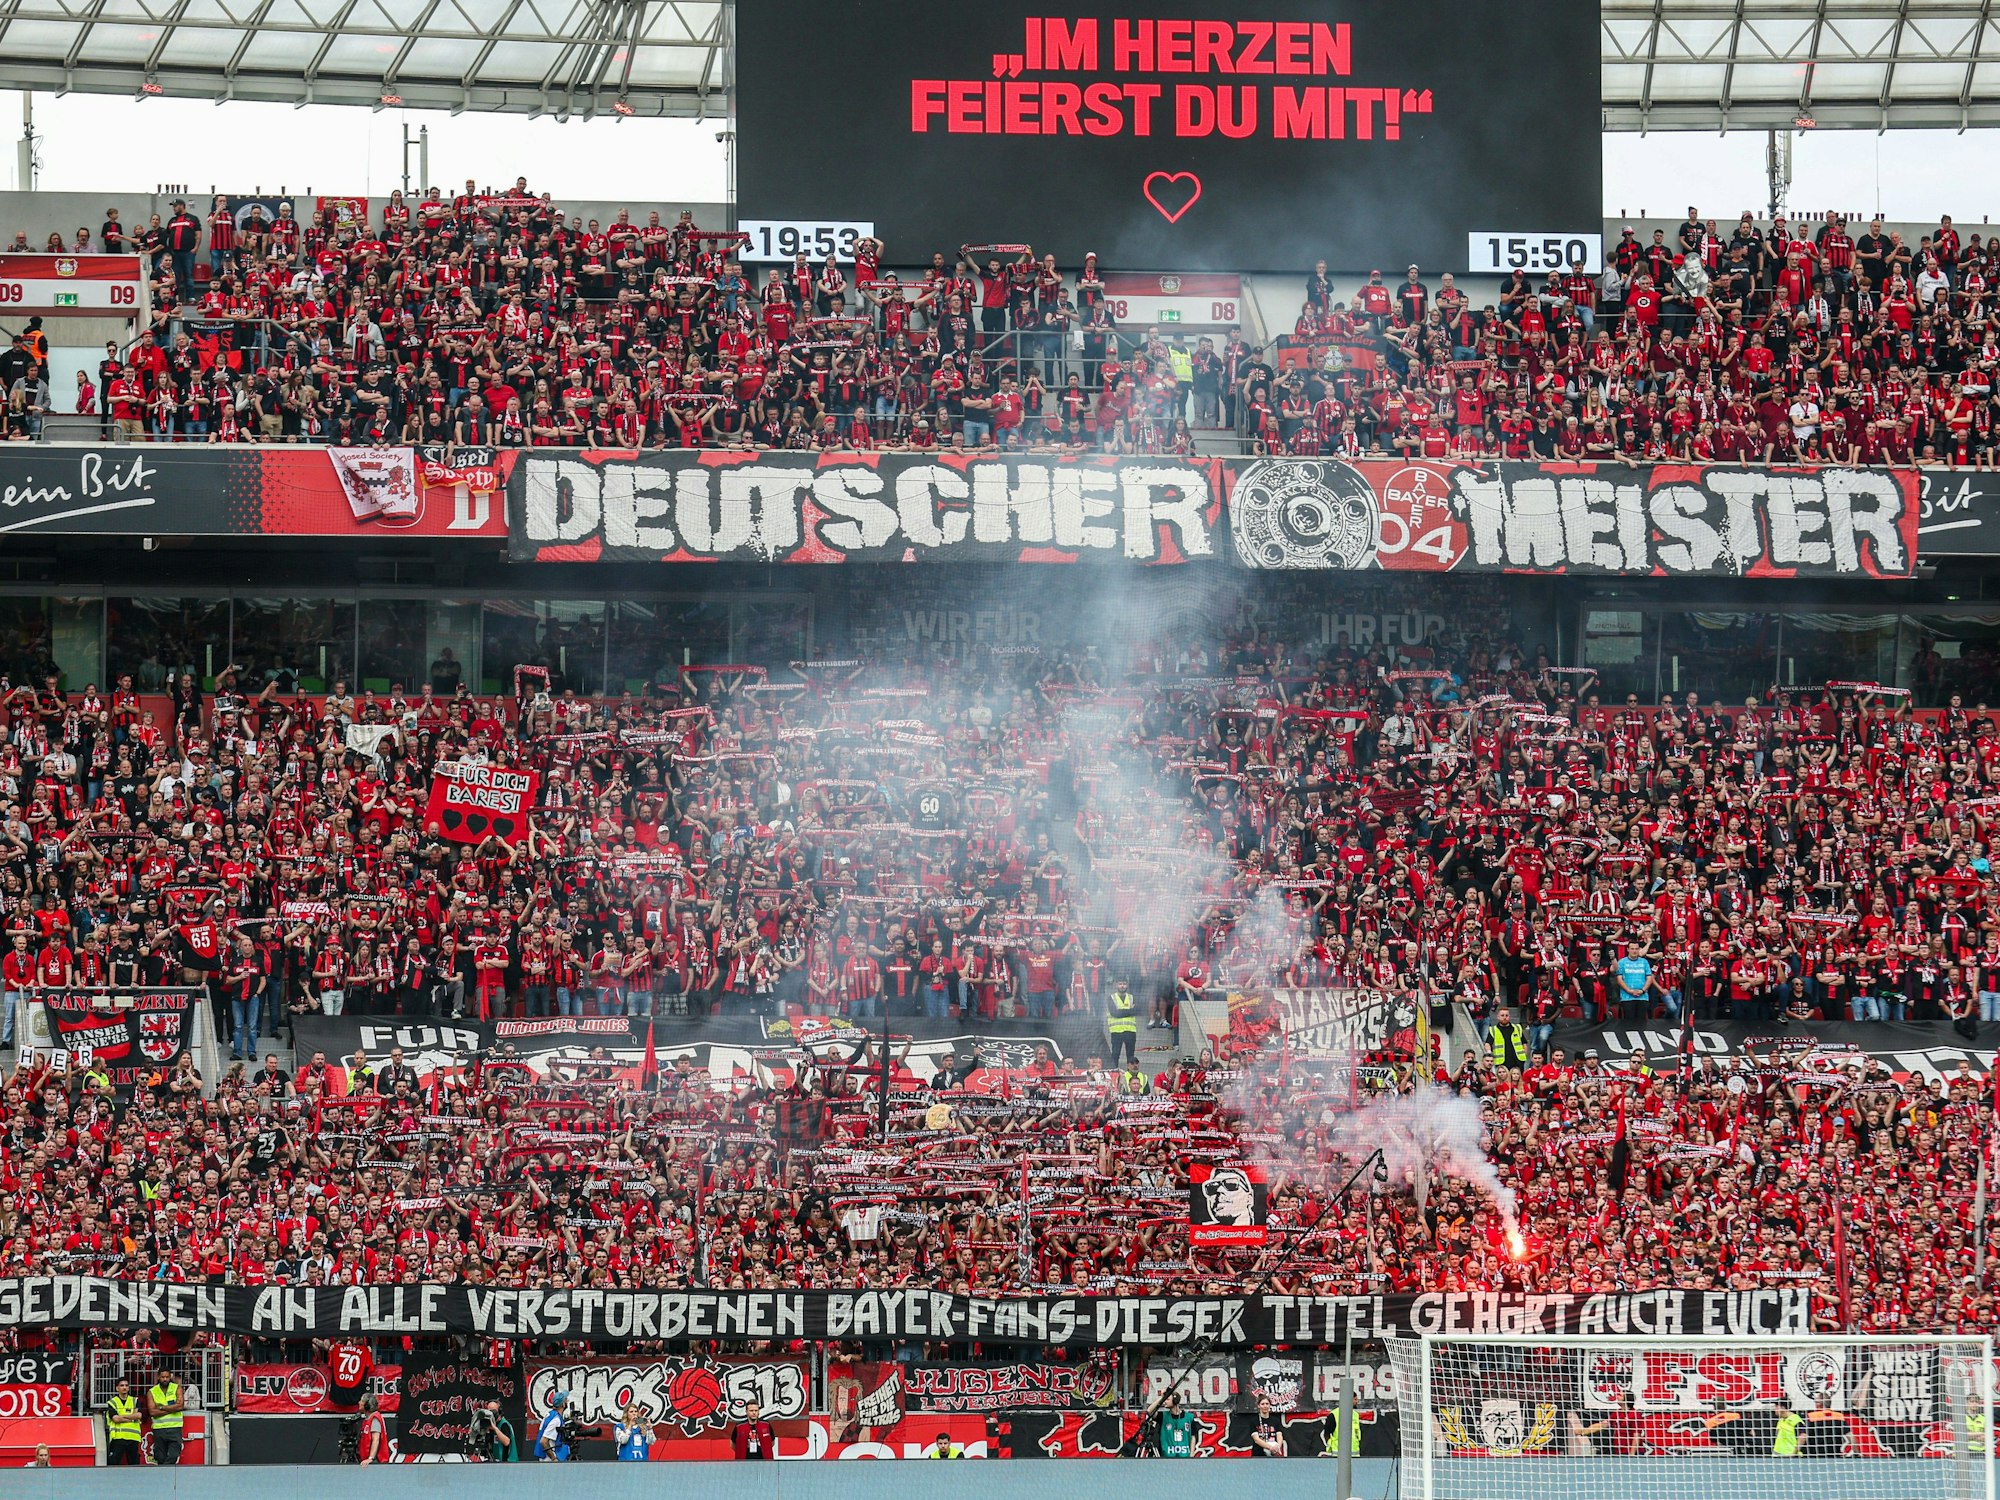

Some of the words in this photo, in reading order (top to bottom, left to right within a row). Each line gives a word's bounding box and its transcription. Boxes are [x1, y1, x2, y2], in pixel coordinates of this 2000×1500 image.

[993, 17, 1097, 77] „IM
[1114, 19, 1352, 76] HERZEN
[911, 80, 1161, 137] FEIERST
[1175, 84, 1257, 138] DU
[1273, 87, 1434, 141] MIT!“
[759, 226, 860, 258] 19:53
[1488, 238, 1588, 268] 15:50
[0, 283, 23, 302] D9
[111, 285, 135, 304] D9
[1212, 301, 1235, 320] D8
[370, 451, 403, 464] Society
[3, 475, 72, 507] ein
[1388, 488, 1449, 508] BAYER
[525, 458, 1213, 560] DEUTSCHER
[1458, 465, 1902, 572] MEISTER
[1379, 512, 1455, 563] 04
[903, 610, 969, 642] WIR
[975, 605, 1041, 643] FÜR
[1321, 613, 1375, 645] IHR
[458, 764, 490, 786] FÜR
[491, 772, 530, 792] DICH
[446, 785, 520, 813] BARESI
[920, 797, 940, 814] 60
[1530, 807, 1548, 815] CLU
[189, 925, 210, 934] WALTER
[190, 932, 211, 949] 65
[61, 1023, 128, 1042] GANSER
[579, 1018, 630, 1032] JUNGS
[359, 1024, 479, 1050] FÜR
[1602, 1028, 1729, 1054] UND
[1746, 1036, 1773, 1045] WEST
[1783, 1037, 1815, 1045] LIONS
[21, 1052, 32, 1064] H
[54, 1053, 65, 1068] E
[82, 1050, 91, 1064] R
[873, 1091, 926, 1101] WRKSELF
[257, 1137, 276, 1156] 23
[400, 1197, 446, 1210] MEISTER
[859, 1208, 867, 1219] 9
[0, 1275, 226, 1329] GEDENKEN
[252, 1286, 316, 1332] AN
[339, 1284, 447, 1332] ALLE
[467, 1289, 804, 1339] VERSTORBENEN
[1263, 1295, 1397, 1343] TITEL
[1579, 1290, 1684, 1335] AUCH
[1701, 1288, 1811, 1335] EUCH
[0, 1357, 64, 1384] yer
[338, 1352, 361, 1374] 70
[1871, 1351, 1932, 1375] WEST
[239, 1375, 286, 1396] LEV
[338, 1373, 354, 1382] OPA
[905, 1363, 1080, 1396] JUGEND
[1641, 1352, 1788, 1406] FSI
[1871, 1375, 1932, 1399] SIDE
[0, 1387, 62, 1416] ons
[529, 1362, 667, 1426] CHAOS
[726, 1364, 806, 1420] 513
[857, 1371, 902, 1411] FREIHEIT
[920, 1391, 1072, 1411] LEVERKUSEN
[1083, 1391, 1097, 1399] 04
[859, 1408, 902, 1426] ULTRAS
[861, 1403, 879, 1419] FÜR
[879, 1396, 896, 1412] DIE
[1872, 1398, 1933, 1421] BOYZ
